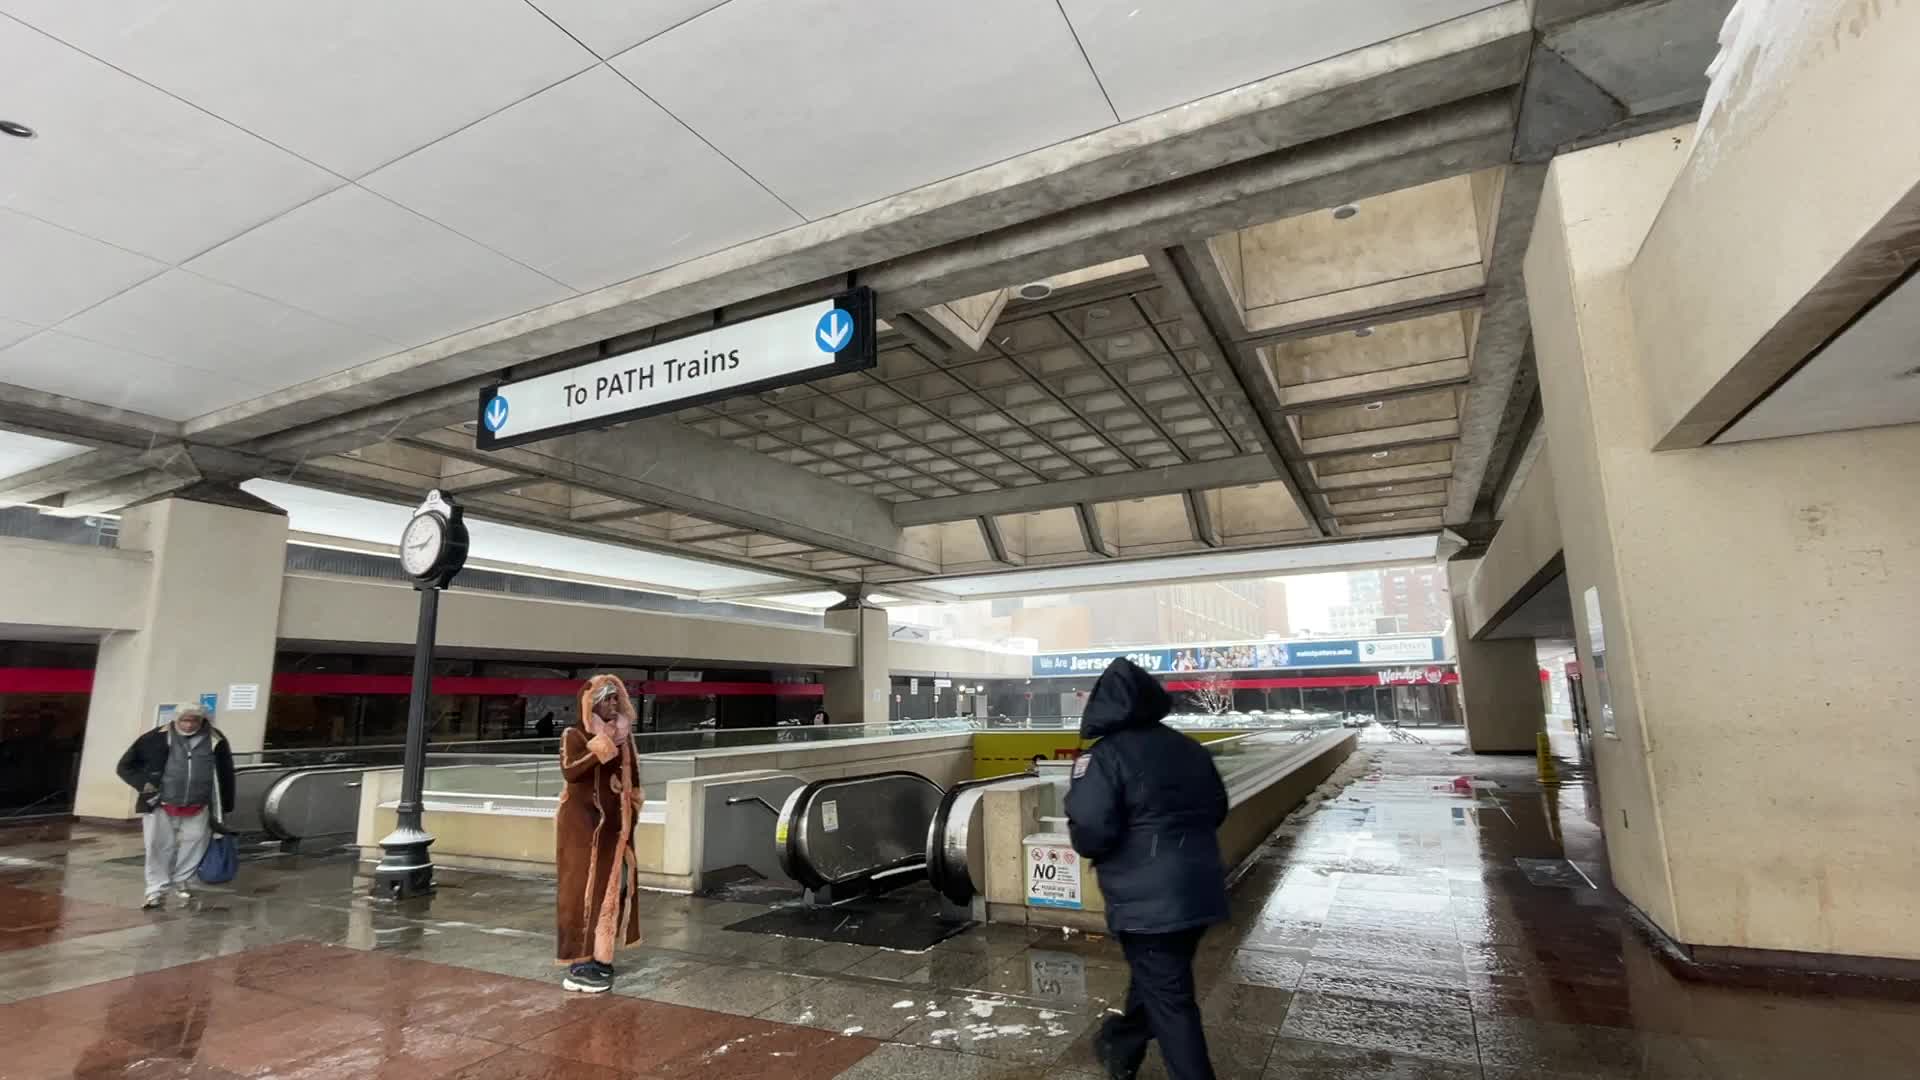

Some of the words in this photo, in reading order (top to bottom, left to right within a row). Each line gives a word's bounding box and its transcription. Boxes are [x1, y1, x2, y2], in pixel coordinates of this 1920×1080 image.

[564, 384, 587, 408] To
[596, 364, 654, 400] PATH
[663, 349, 740, 383] Trains
[1039, 656, 1053, 669] We
[1054, 656, 1068, 668] Are
[1070, 655, 1117, 671] Jerse
[1033, 863, 1056, 880] NO
